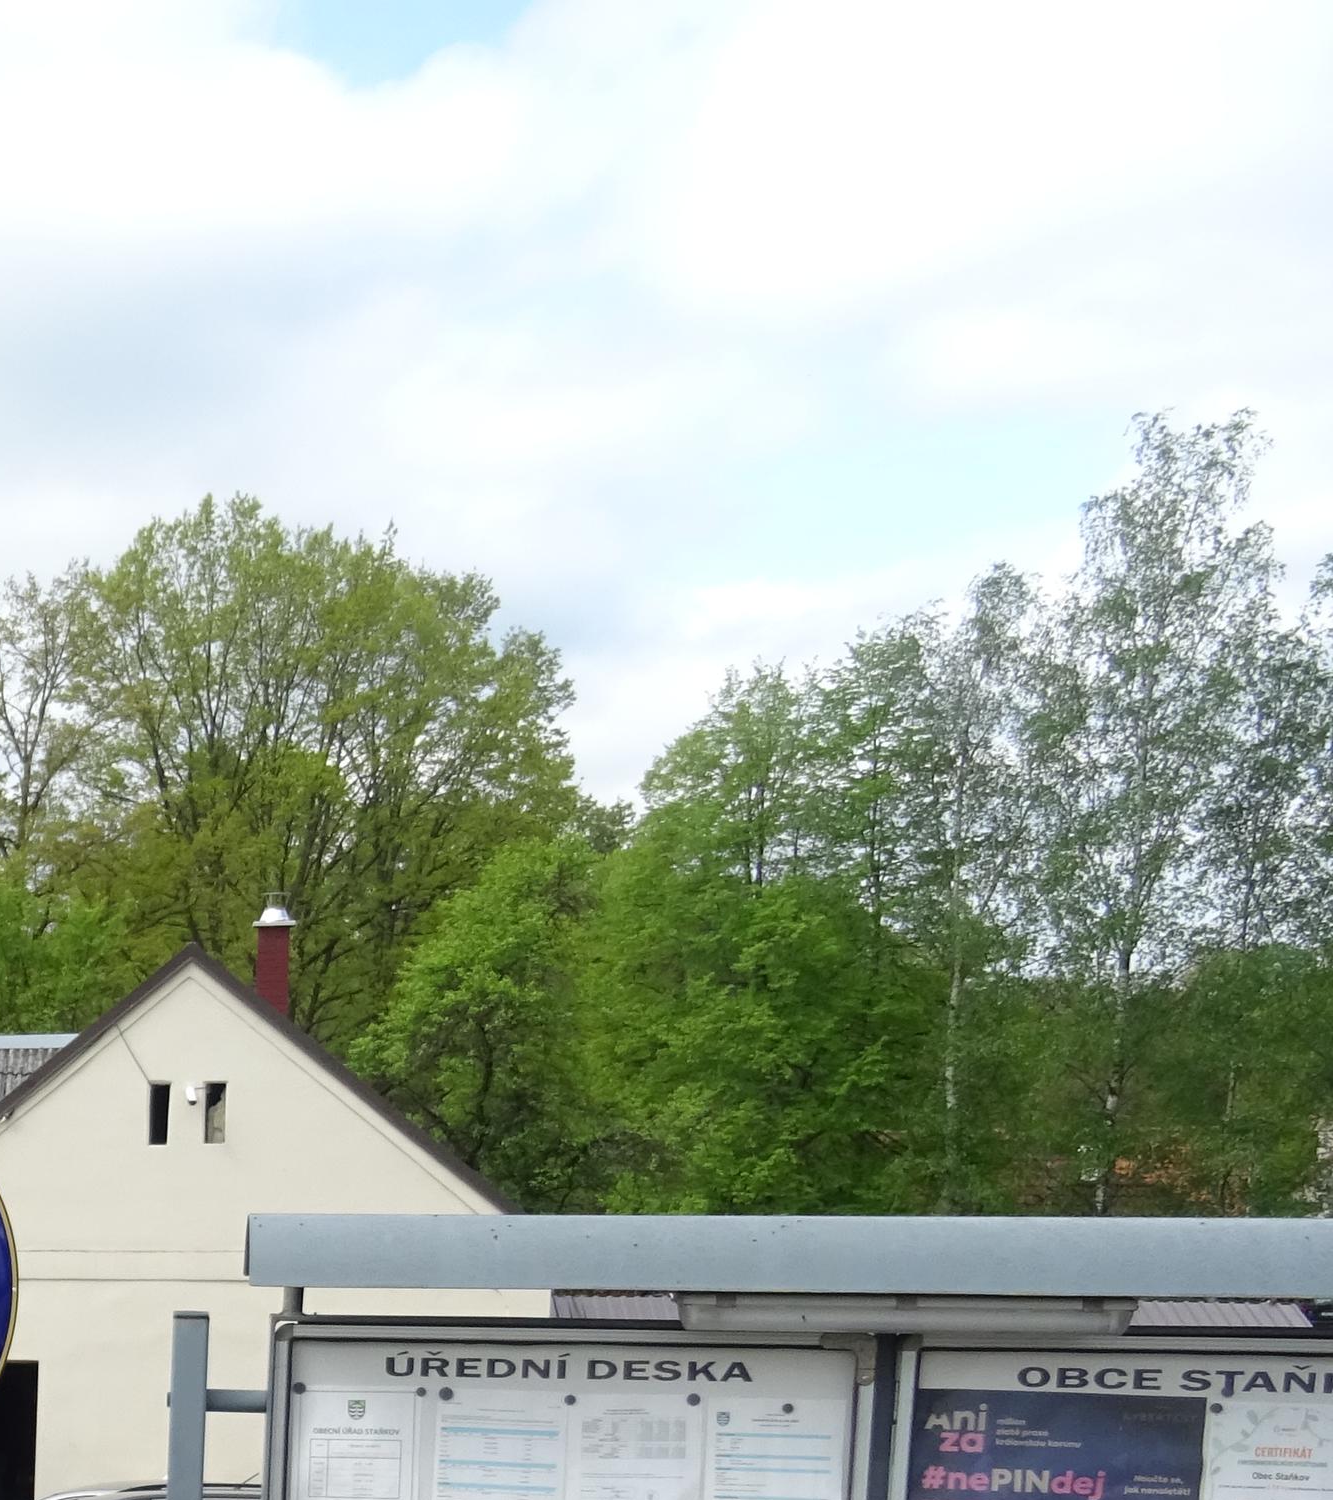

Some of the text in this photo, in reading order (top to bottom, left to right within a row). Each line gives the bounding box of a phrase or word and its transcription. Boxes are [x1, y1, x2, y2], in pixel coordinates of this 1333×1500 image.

[385, 1350, 754, 1382] ÚŘEDNÍ DESKA
[1017, 1364, 1333, 1394] OBCE STAŇ
[312, 1426, 340, 1435] OBECNÍ
[342, 1426, 364, 1435] ÚŘAD
[939, 1432, 985, 1453] za
[1254, 1446, 1313, 1459] CERTIFIKÁT
[1252, 1471, 1311, 1482] Obec Staňkov
